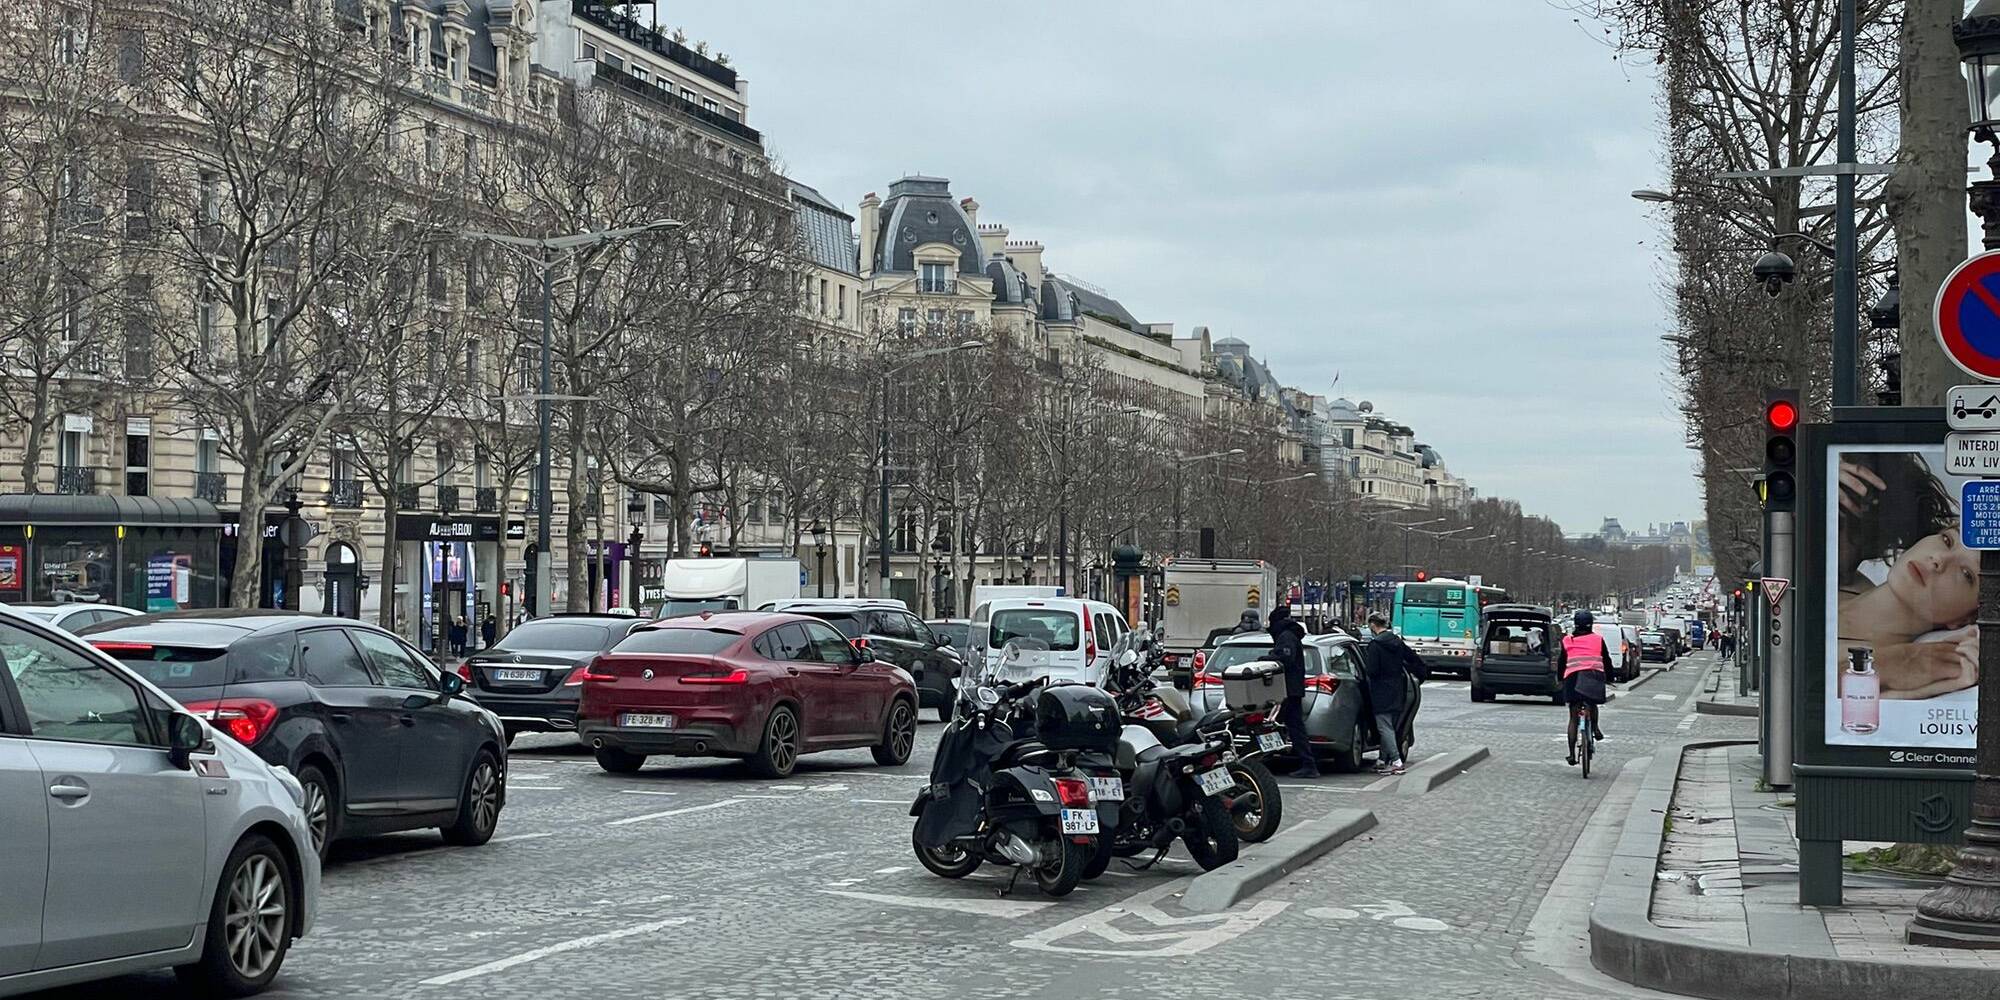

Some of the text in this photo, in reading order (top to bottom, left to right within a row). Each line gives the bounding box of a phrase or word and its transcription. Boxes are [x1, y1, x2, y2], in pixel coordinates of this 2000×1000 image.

[1955, 456, 1976, 468] AUX
[1973, 503, 1988, 511] DES
[1970, 519, 1986, 528] SUR
[1976, 536, 1985, 544] ET
[646, 589, 661, 599] YVES
[1927, 708, 1969, 720] SPELL
[1920, 723, 1964, 735] LOUIS
[1905, 752, 1933, 763] Clear
